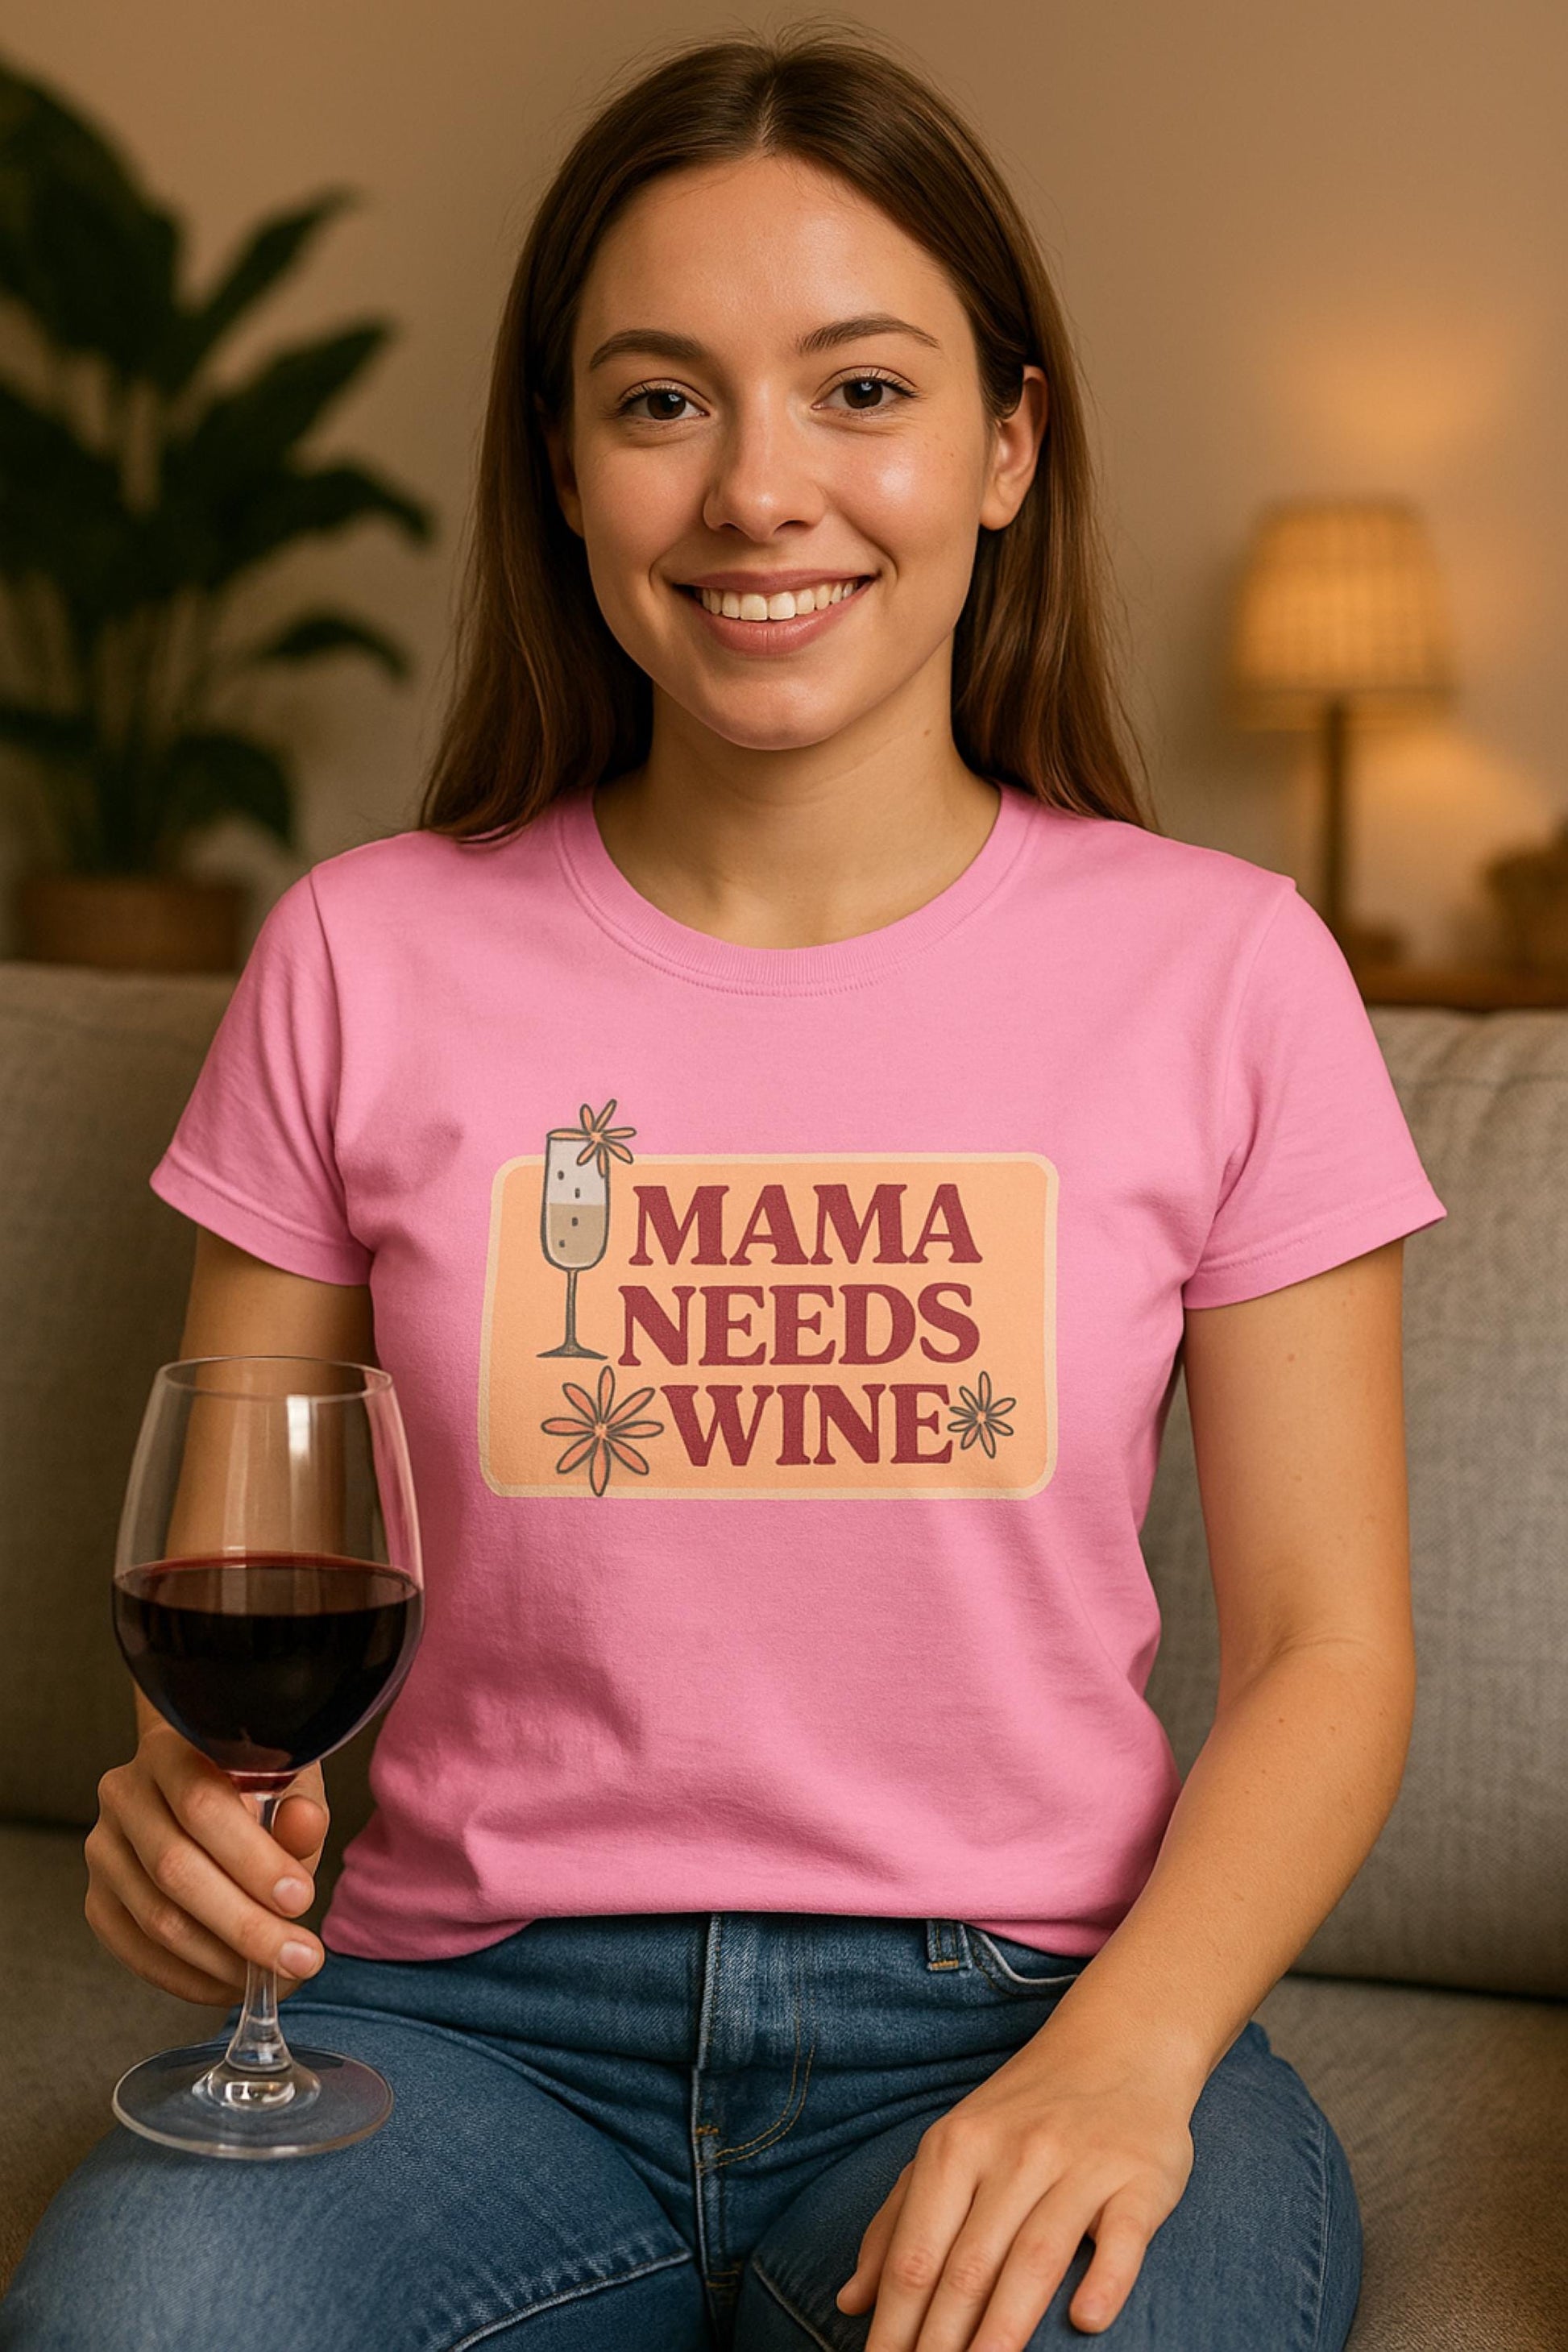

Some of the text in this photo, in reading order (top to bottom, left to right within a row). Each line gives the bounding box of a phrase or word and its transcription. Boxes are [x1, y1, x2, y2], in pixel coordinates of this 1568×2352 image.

[628, 1184, 983, 1266] MAMA
[617, 1282, 980, 1367] NEEDS
[659, 1383, 954, 1467] WINE
